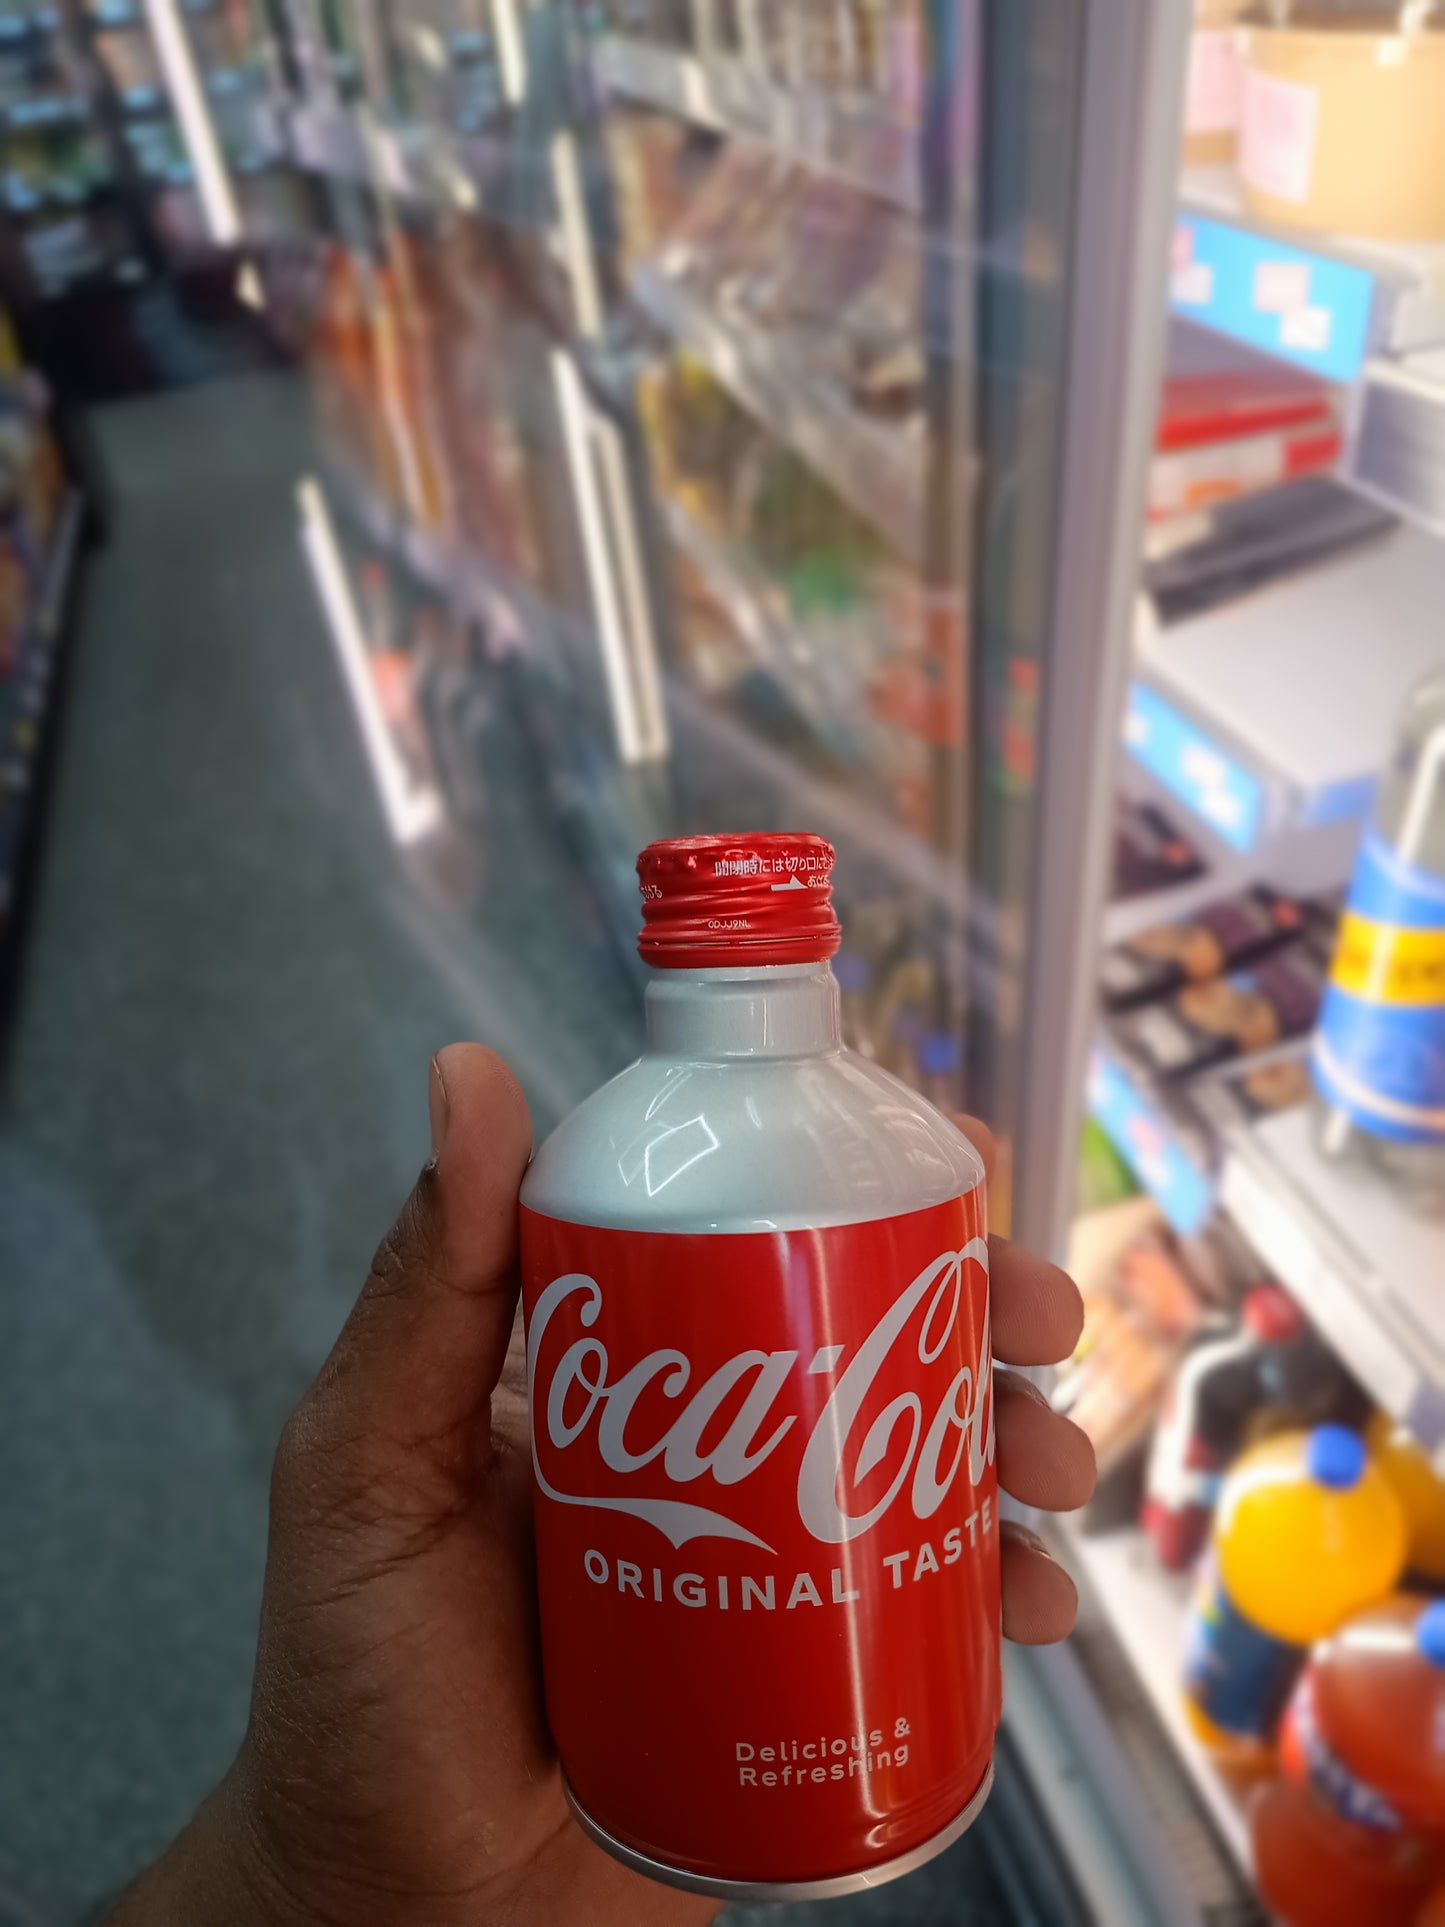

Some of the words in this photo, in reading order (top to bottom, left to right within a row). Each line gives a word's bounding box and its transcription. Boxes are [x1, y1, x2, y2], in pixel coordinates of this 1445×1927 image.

[584, 1549, 860, 1611] ORIGINAL
[883, 1495, 993, 1590] TASTE
[735, 1729, 884, 1762] Delicious
[894, 1717, 910, 1738] &
[739, 1744, 909, 1787] Refreshing
